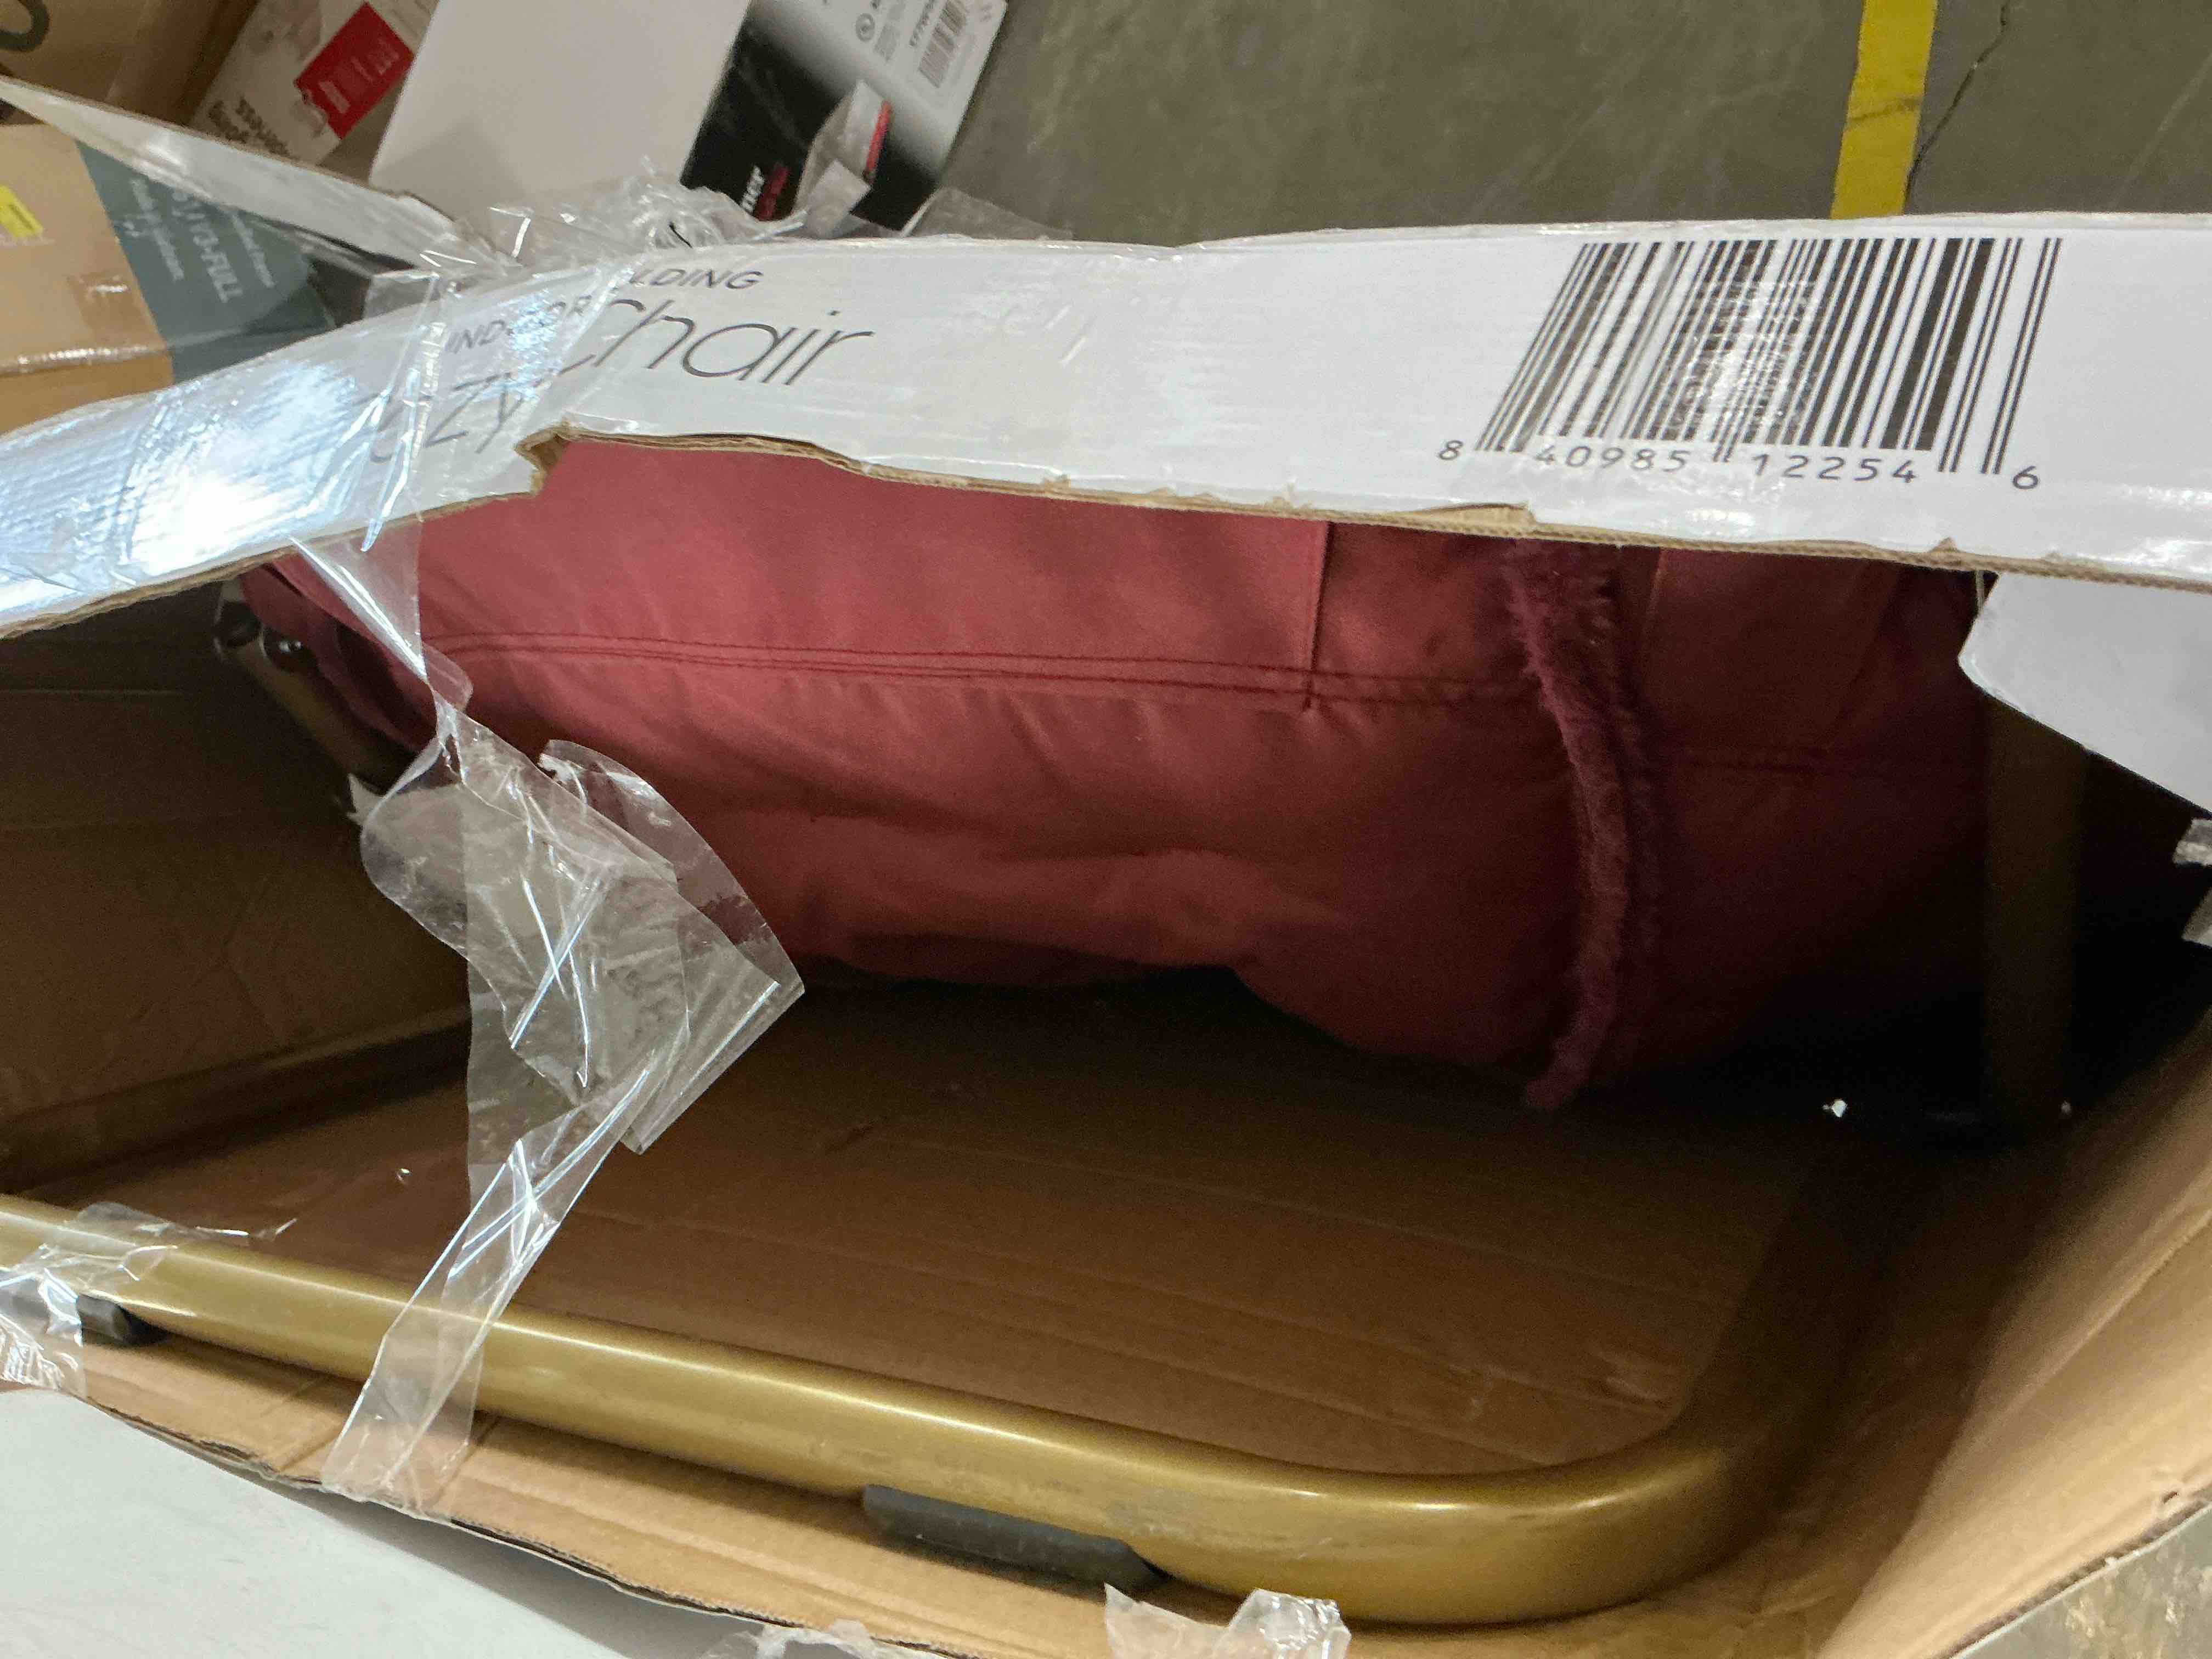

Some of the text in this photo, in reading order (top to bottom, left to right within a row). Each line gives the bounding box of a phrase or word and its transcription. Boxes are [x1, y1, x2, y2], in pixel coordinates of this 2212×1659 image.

[619, 268, 763, 290] LDING
[540, 298, 874, 385] Chair
[1438, 440, 2039, 490] 8 40985 12254 6
